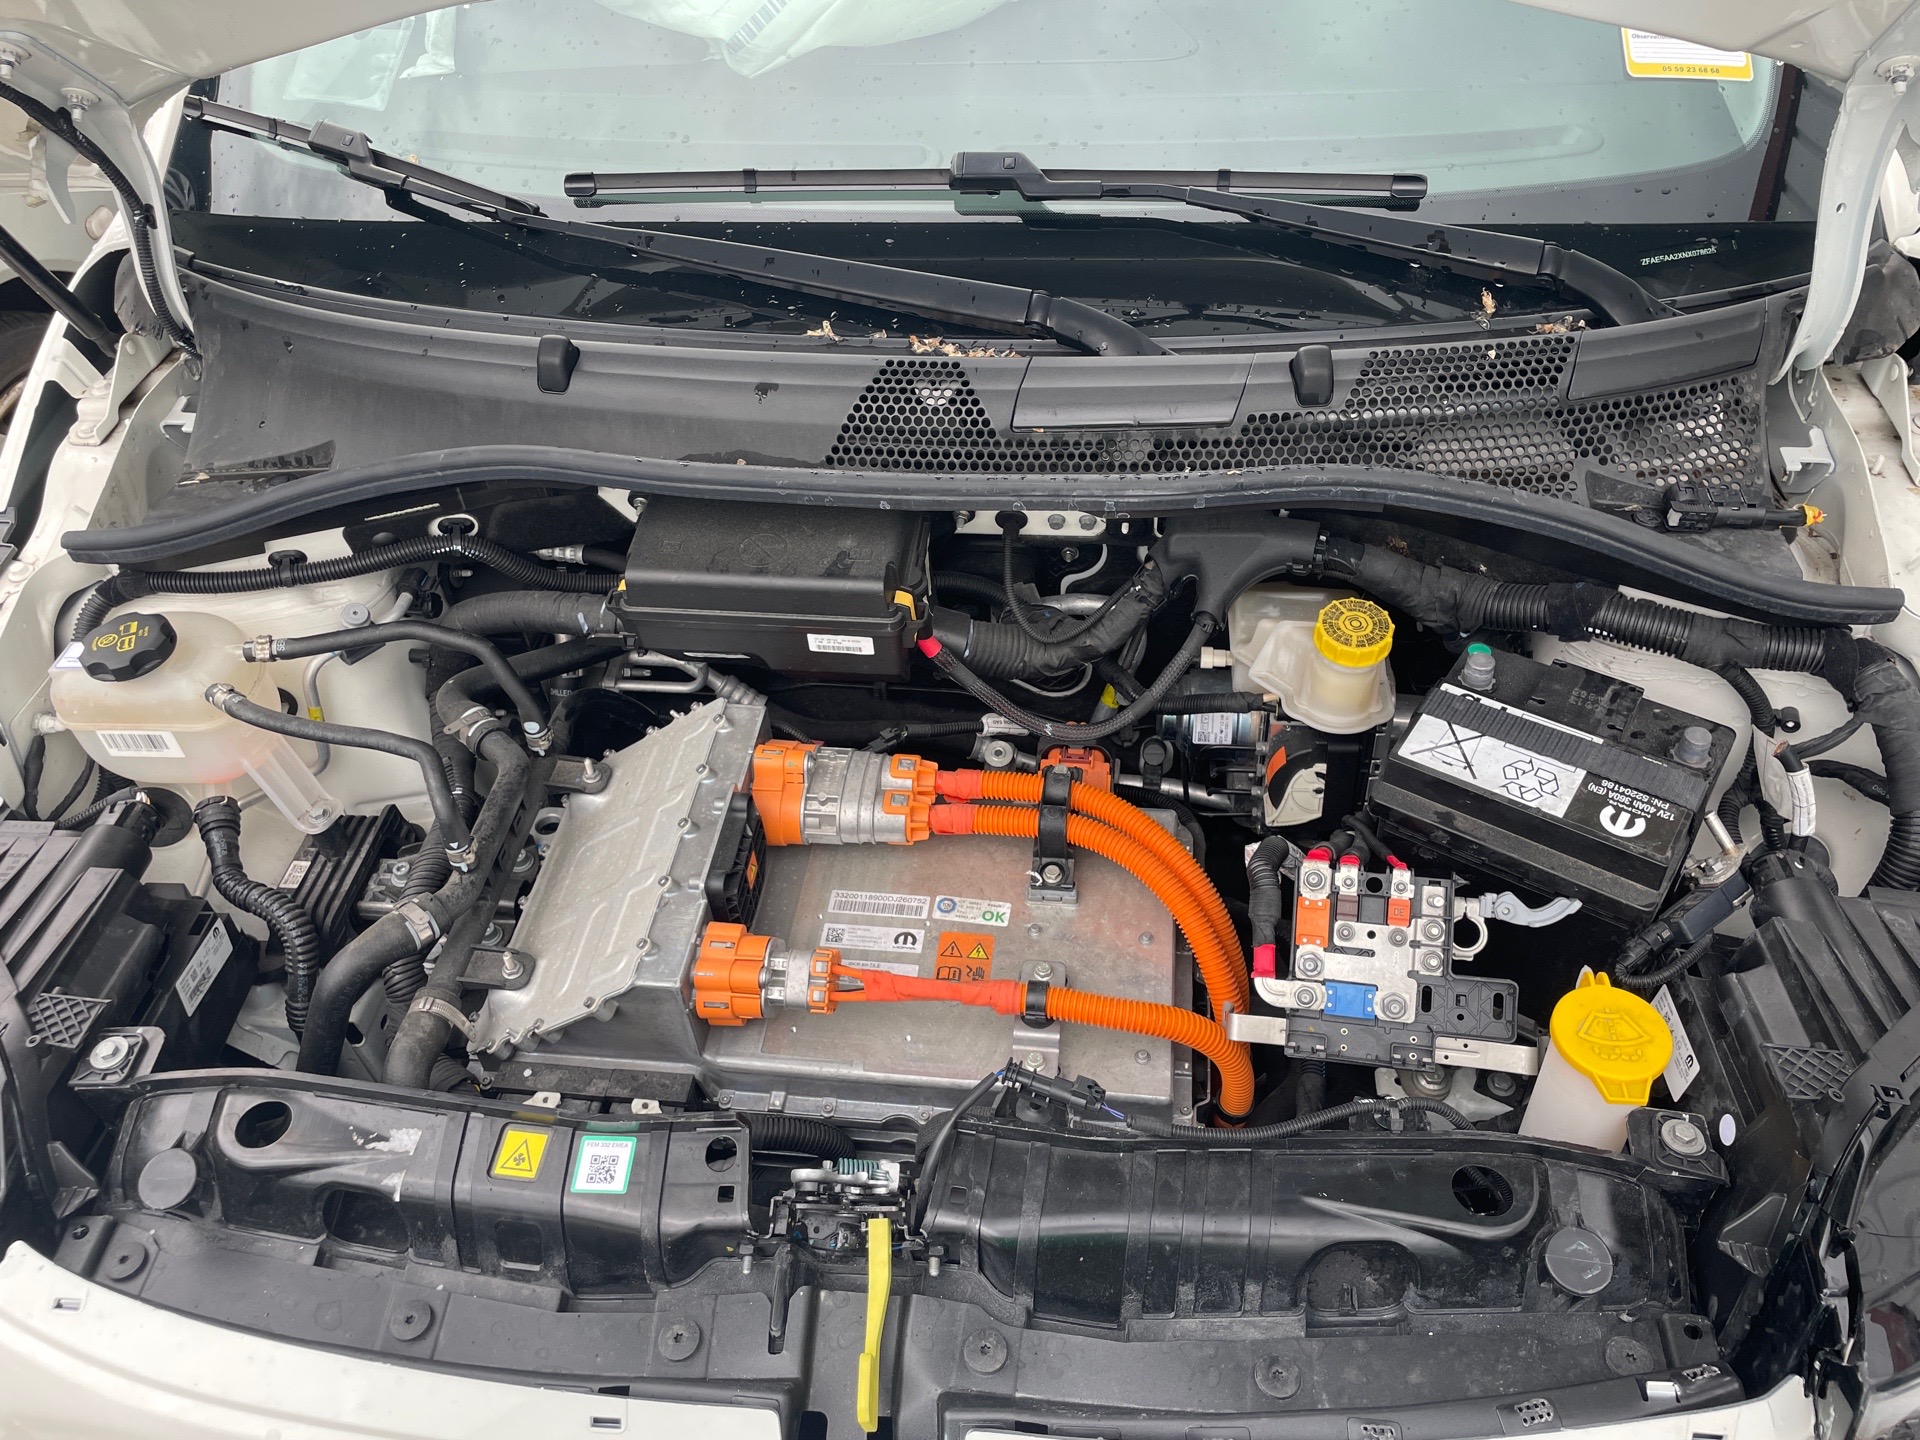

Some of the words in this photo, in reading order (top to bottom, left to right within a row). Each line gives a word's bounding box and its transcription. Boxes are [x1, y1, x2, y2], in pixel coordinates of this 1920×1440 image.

[1587, 782, 1608, 796] (EN)
[1601, 779, 1650, 802] 52204186
[1608, 790, 1632, 804] 360A
[1650, 797, 1670, 810] PN:
[1632, 802, 1657, 813] 40Ah
[1656, 810, 1675, 821] 12V
[981, 910, 1007, 923] OK
